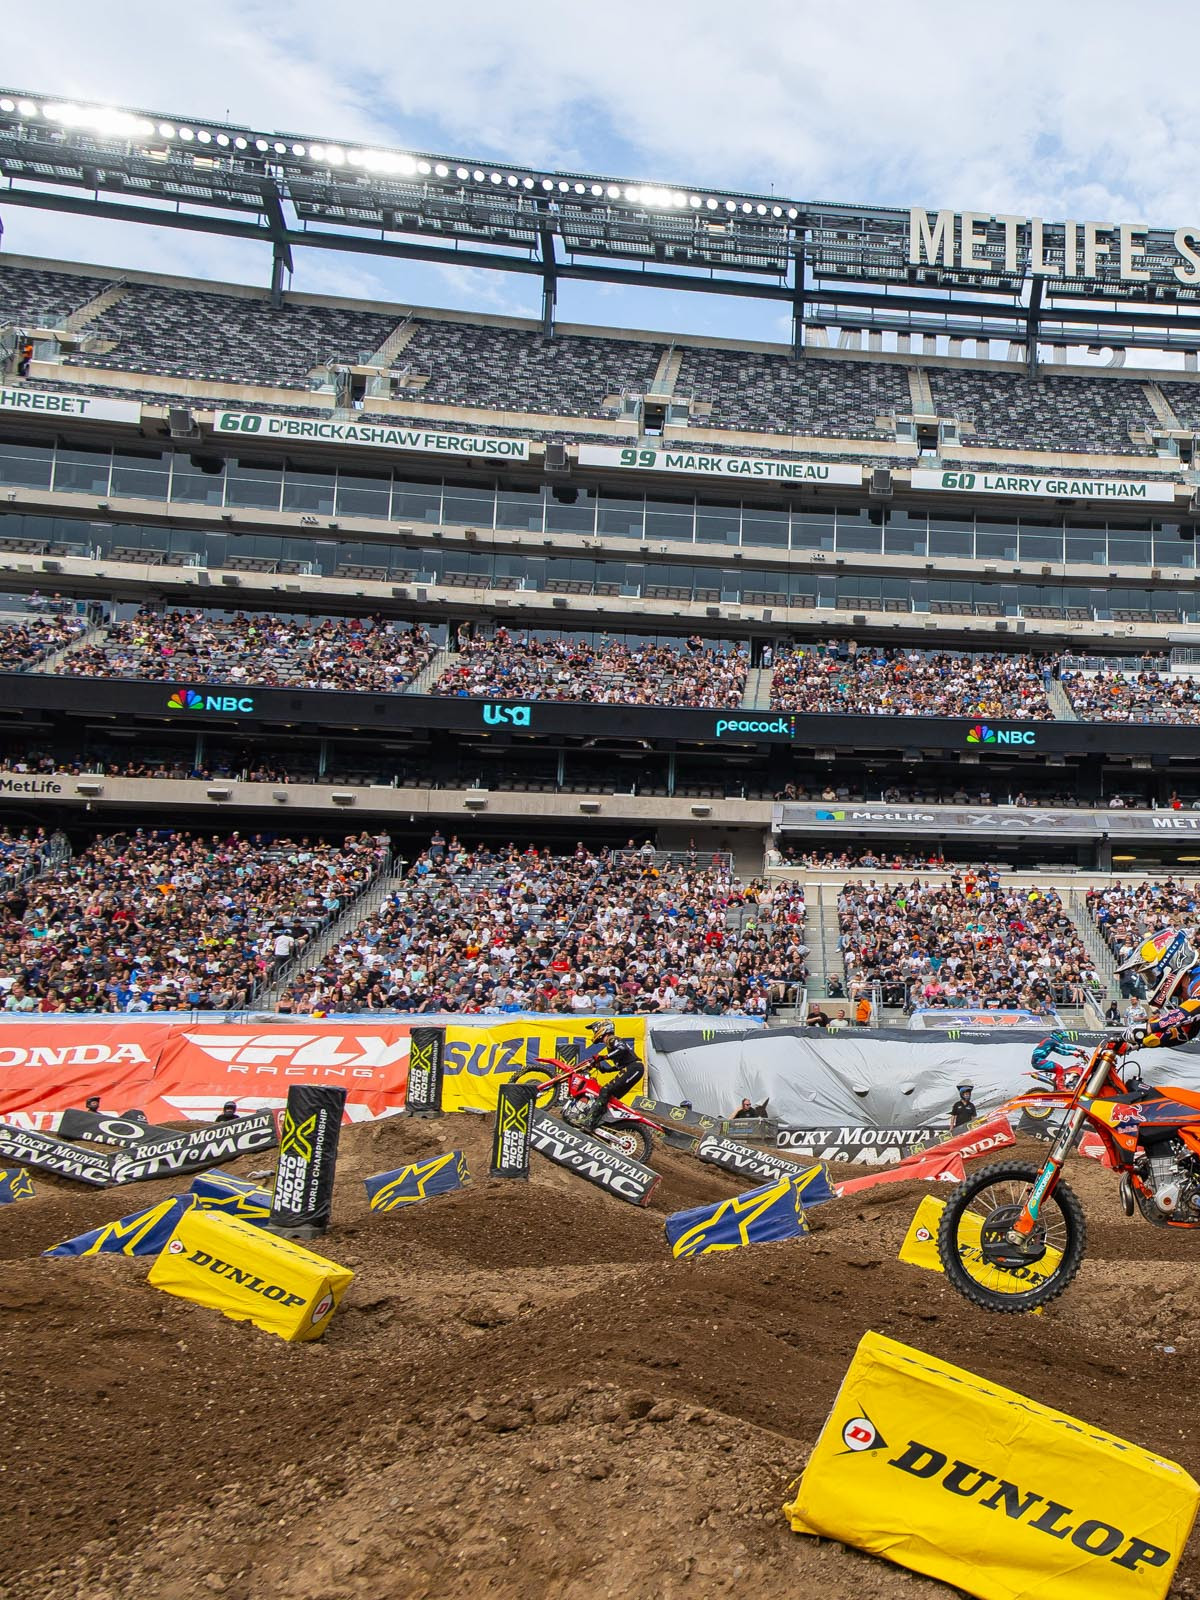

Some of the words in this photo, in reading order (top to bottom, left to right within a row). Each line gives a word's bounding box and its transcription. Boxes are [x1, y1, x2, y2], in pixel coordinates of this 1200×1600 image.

[909, 207, 1149, 281] METLIFE
[0, 391, 90, 413] HREBET
[220, 412, 261, 433] 60
[269, 414, 421, 447] D'BRICKASHAW
[423, 431, 524, 457] FERGUSON
[620, 449, 656, 468] 99
[665, 452, 721, 474] MARK
[726, 456, 829, 480] GASTINEAU
[941, 471, 975, 490] 60
[984, 475, 1042, 494] LARRY
[1046, 478, 1147, 498] GRANTHAM
[206, 695, 253, 713] NBC
[716, 718, 788, 736] peacock
[997, 731, 1035, 744] NBC
[0, 780, 62, 794] MetLife
[852, 812, 935, 821] MetLife
[227, 1064, 380, 1079] RACING
[414, 1069, 422, 1101] MOTO
[420, 1069, 428, 1103] CROSS
[13, 1133, 53, 1151] ROCKY
[135, 1137, 185, 1160] ROCKY
[188, 1114, 270, 1147] MOUNTAIN
[312, 1108, 328, 1177] CHAMPIONSHIP
[502, 1130, 512, 1168] SUPER
[509, 1132, 518, 1166] MOTO
[516, 1131, 526, 1169] CROSS
[541, 1118, 582, 1152] ROCKY
[579, 1139, 653, 1183] MOUNTAIN
[720, 1138, 756, 1155] ROCKY
[52, 1161, 113, 1183] MC
[115, 1148, 192, 1182] ATV
[199, 1128, 273, 1161] MC
[700, 1145, 751, 1168] ATV
[273, 1154, 289, 1212] SUPER
[281, 1156, 296, 1209] MOTO
[291, 1157, 308, 1213] CROSS
[308, 1177, 319, 1211] WORLD
[577, 1158, 644, 1198] MC
[187, 1250, 307, 1308] DUNLOP
[846, 1426, 872, 1444] D
[887, 1440, 1171, 1572] DUNLOP
